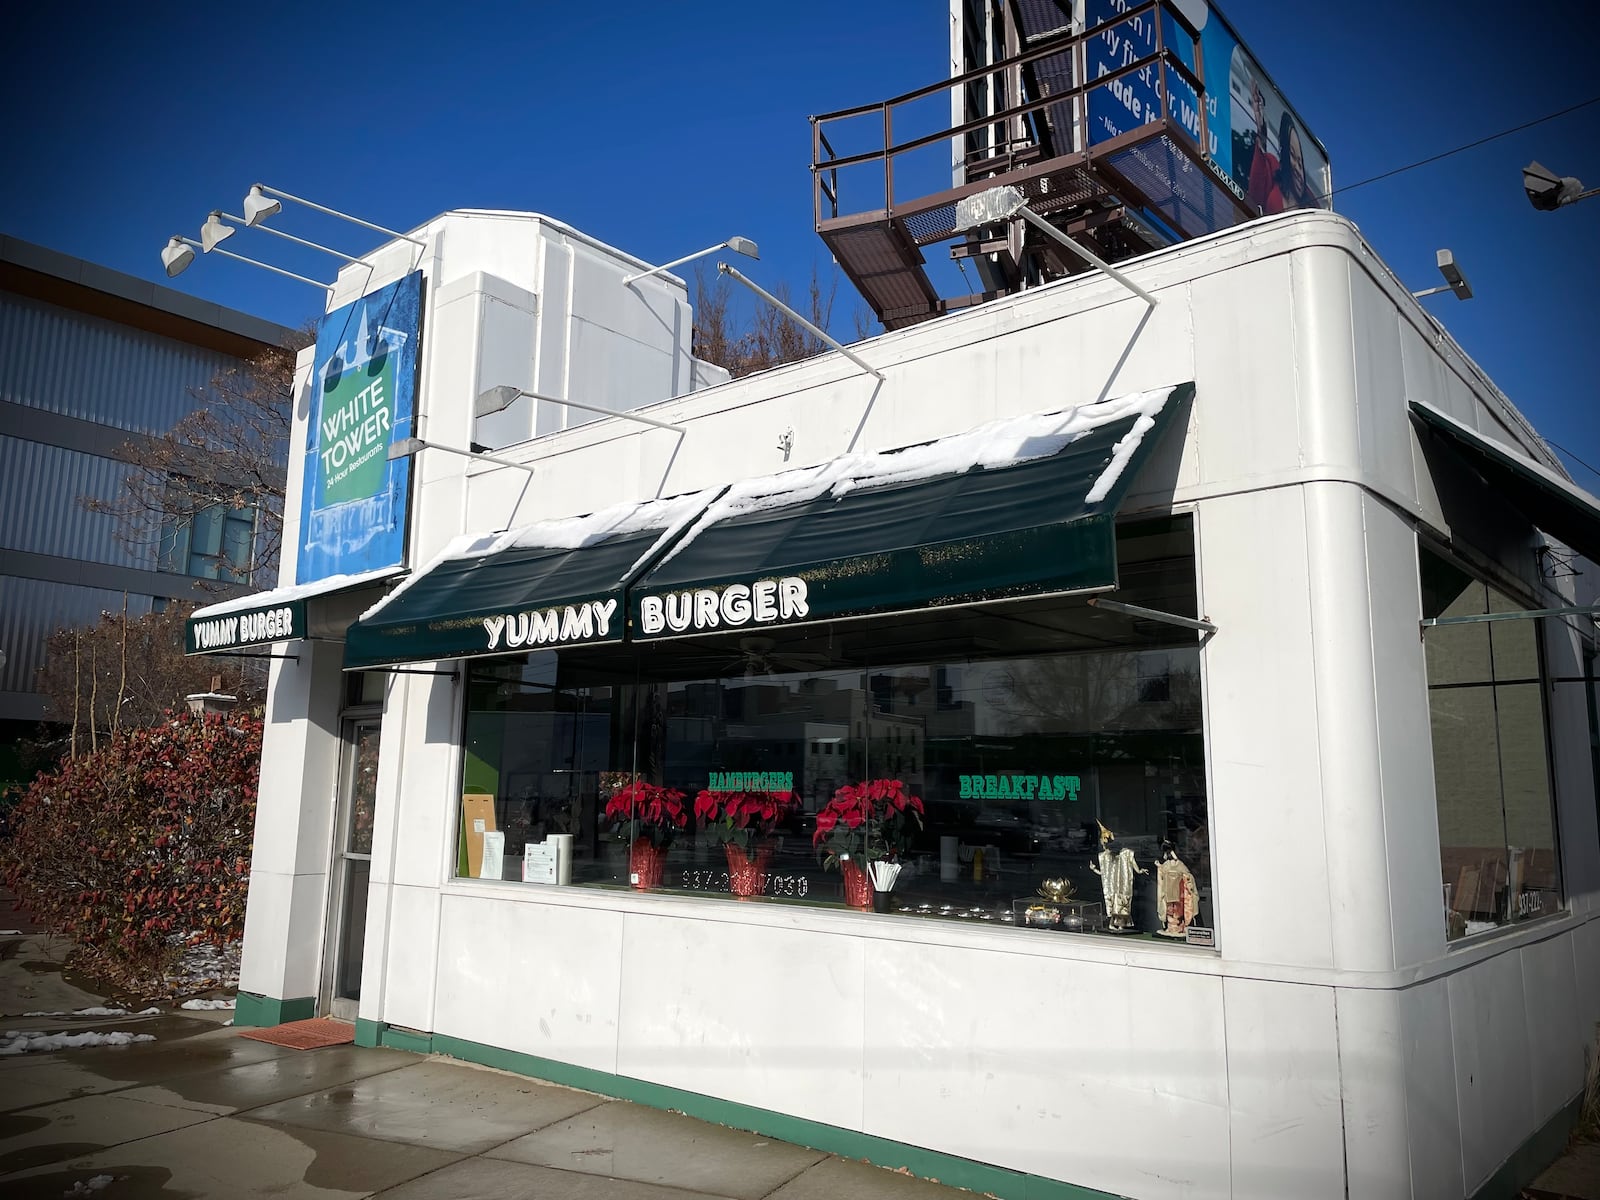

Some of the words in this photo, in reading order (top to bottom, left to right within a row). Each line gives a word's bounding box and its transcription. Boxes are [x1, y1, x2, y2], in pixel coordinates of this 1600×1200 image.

[322, 376, 384, 442] WHITE
[321, 406, 390, 474] TOWER
[194, 616, 238, 650] YUMMY
[240, 607, 293, 642] BURGER
[483, 598, 617, 649] YUMMY
[640, 576, 810, 634] BURGER
[708, 771, 794, 792] HAMBURGERS
[959, 775, 1080, 801] BREAKFAST
